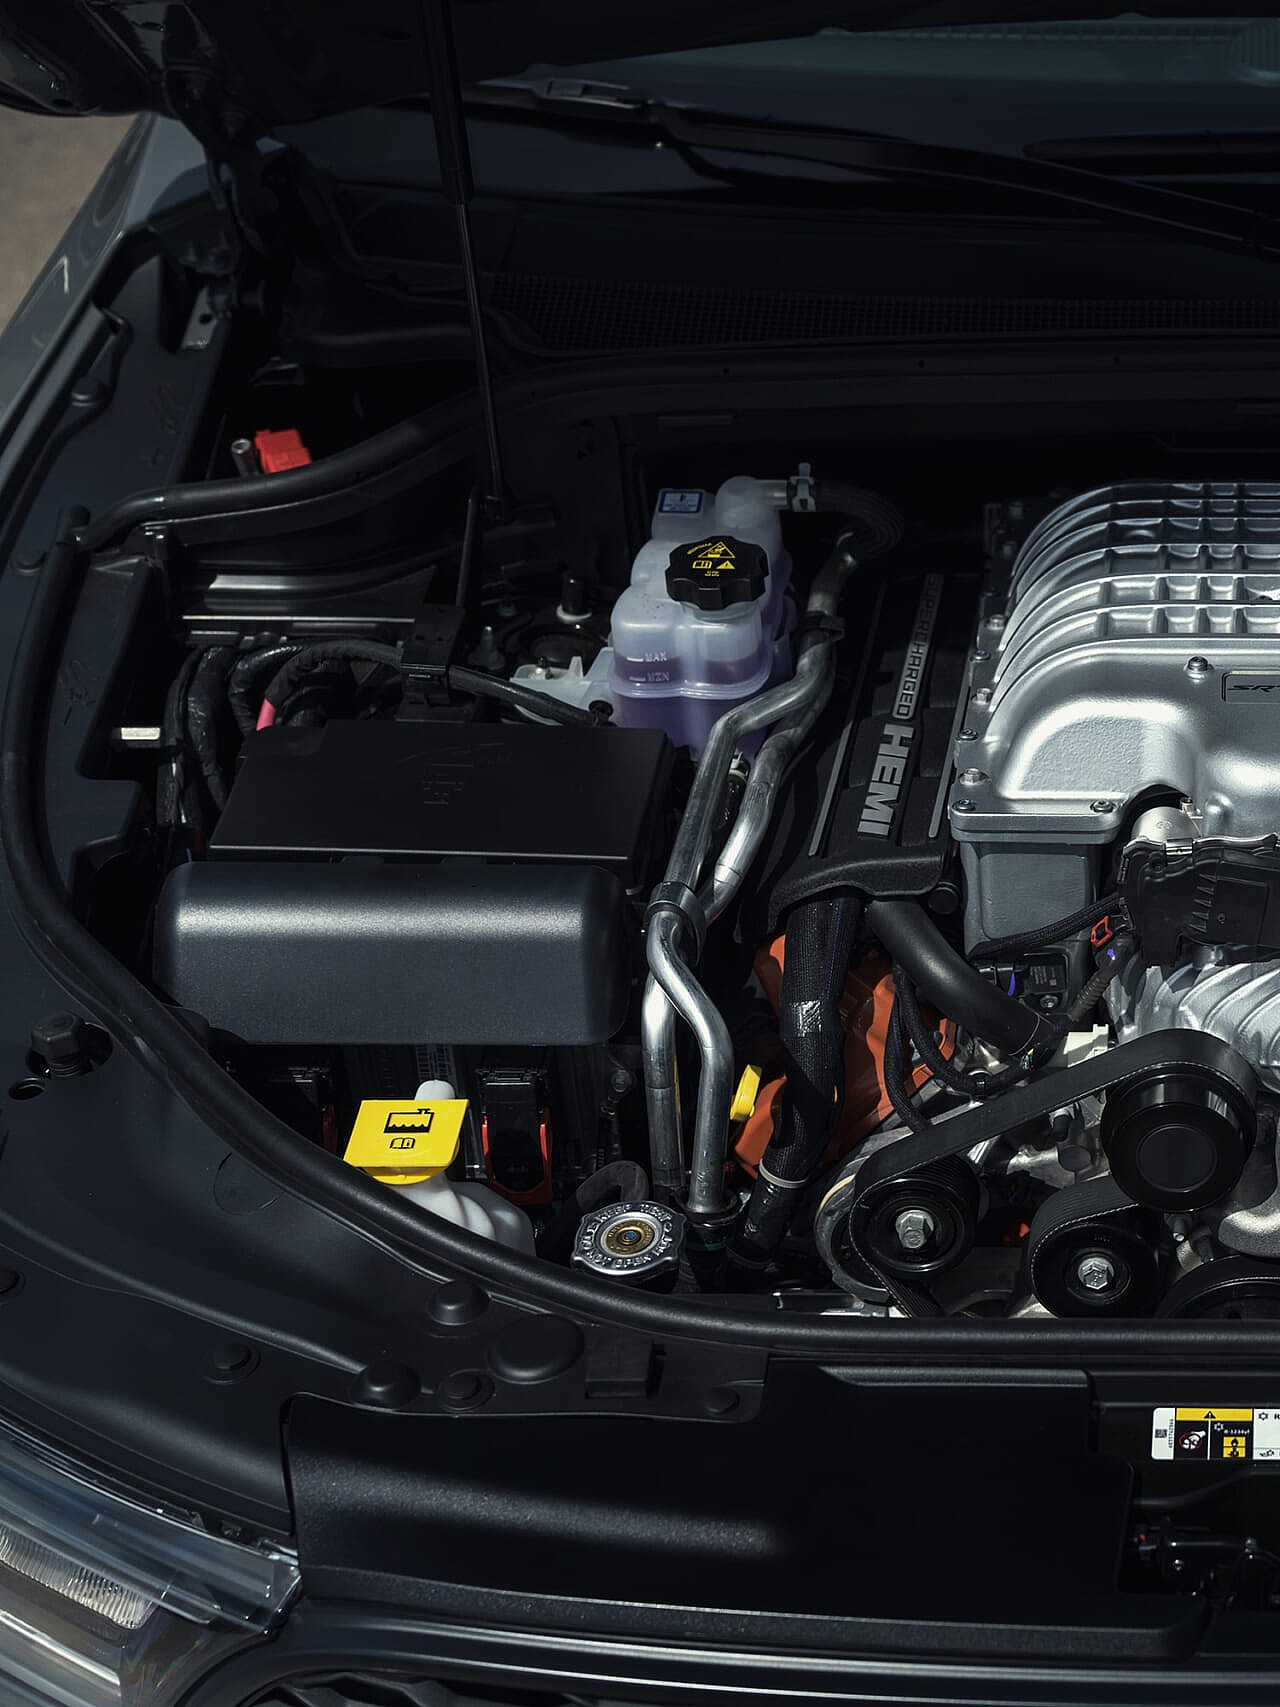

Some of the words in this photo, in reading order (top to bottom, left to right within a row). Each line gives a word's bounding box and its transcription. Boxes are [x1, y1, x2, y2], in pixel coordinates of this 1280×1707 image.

[645, 651, 667, 662] MAX
[647, 671, 669, 682] MIN
[897, 576, 940, 717] SUPERCHARGED
[857, 722, 914, 837] HEMI
